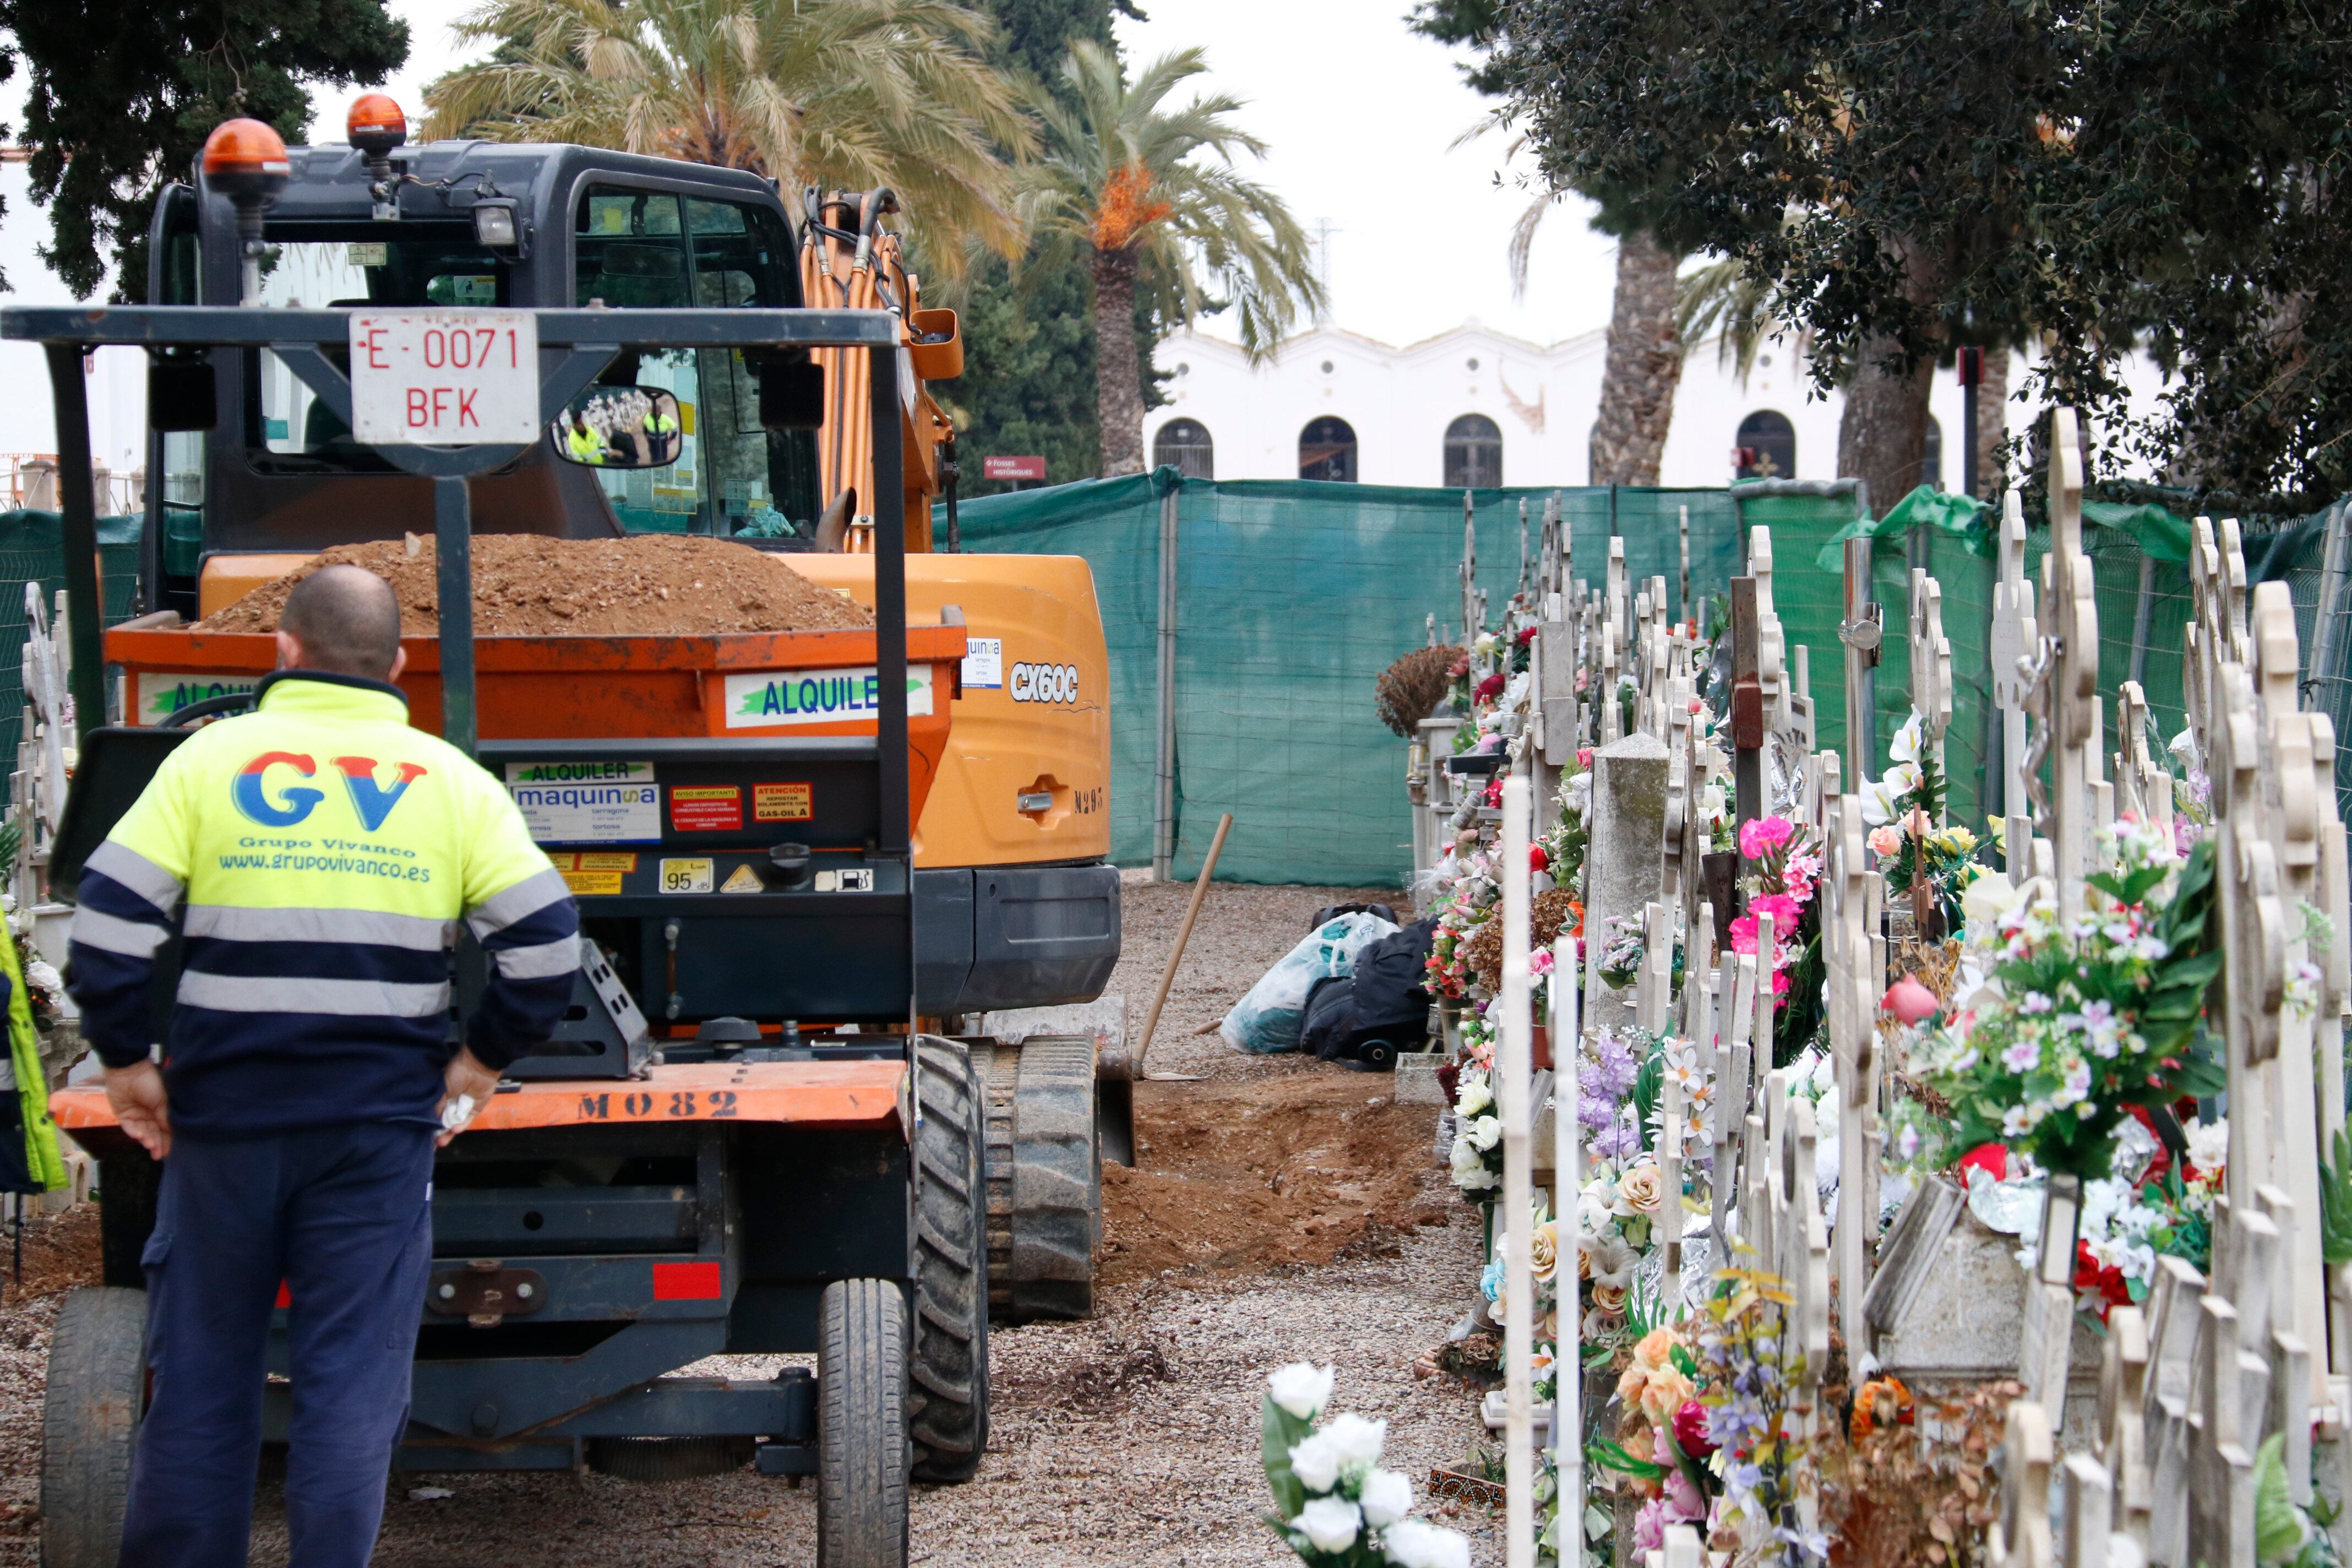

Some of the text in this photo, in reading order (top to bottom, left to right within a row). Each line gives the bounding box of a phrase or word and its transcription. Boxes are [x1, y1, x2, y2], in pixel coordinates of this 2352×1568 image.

[406, 388, 479, 427] BFK
[1010, 661, 1078, 705] CX60C
[762, 675, 879, 716] ALQUILE
[531, 762, 629, 782] ALQUILER
[517, 788, 656, 809] maquinsa
[758, 786, 806, 794] ATENCIÓN
[799, 808, 807, 816] A
[238, 836, 417, 858] Grupo Vivanco
[219, 853, 431, 883] www.grupovivanco.es
[667, 872, 692, 890] 95
[577, 1091, 738, 1120] M082
